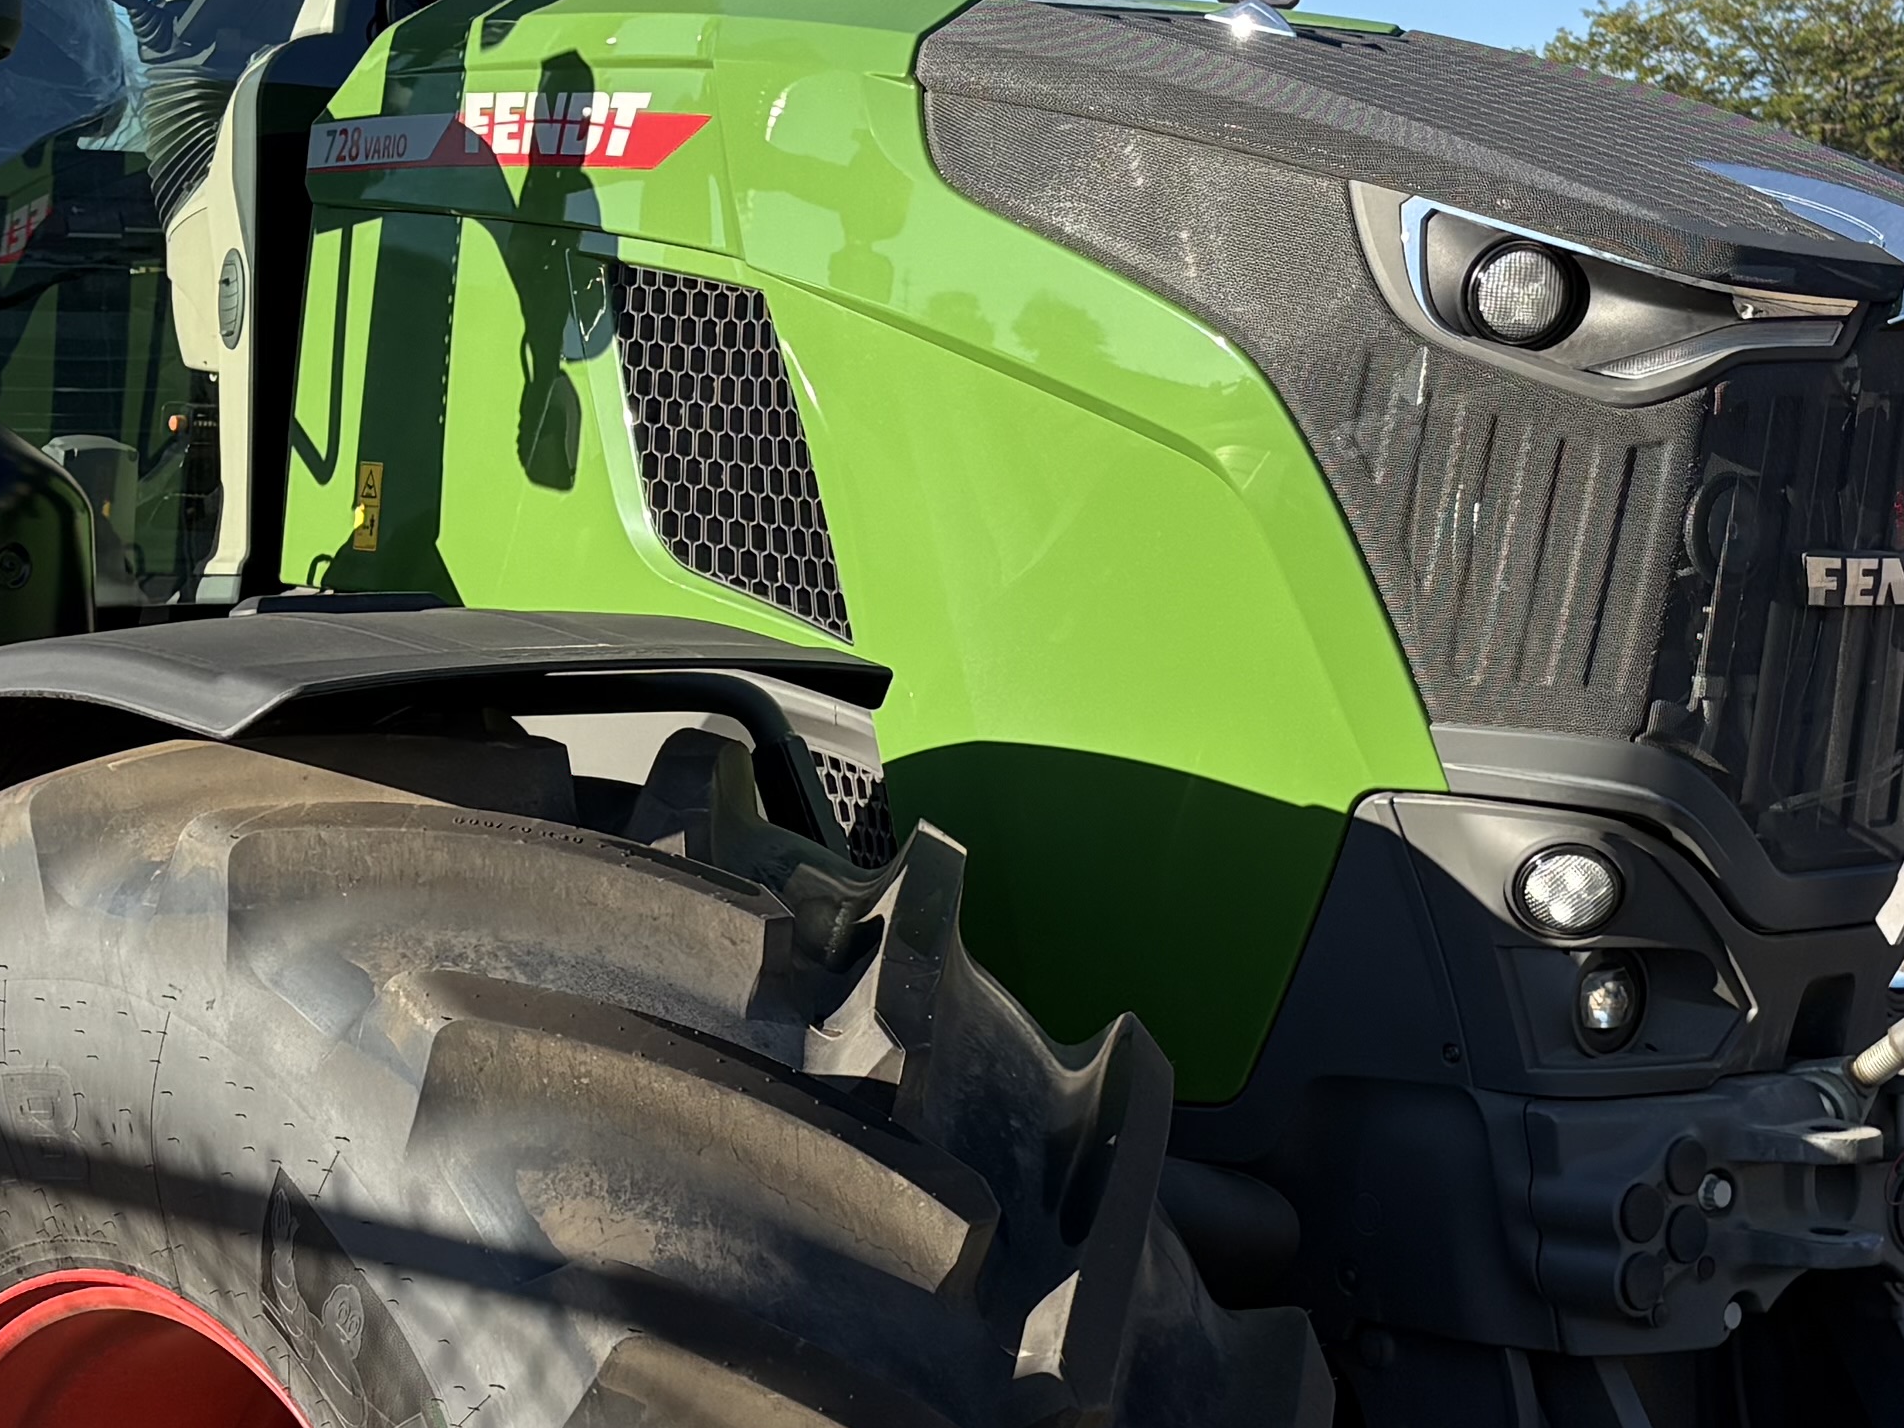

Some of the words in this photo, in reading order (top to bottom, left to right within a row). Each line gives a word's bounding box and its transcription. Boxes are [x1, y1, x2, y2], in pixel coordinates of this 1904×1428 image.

[324, 127, 362, 163] 728
[363, 133, 408, 160] VARIO
[464, 91, 653, 157] FENDT
